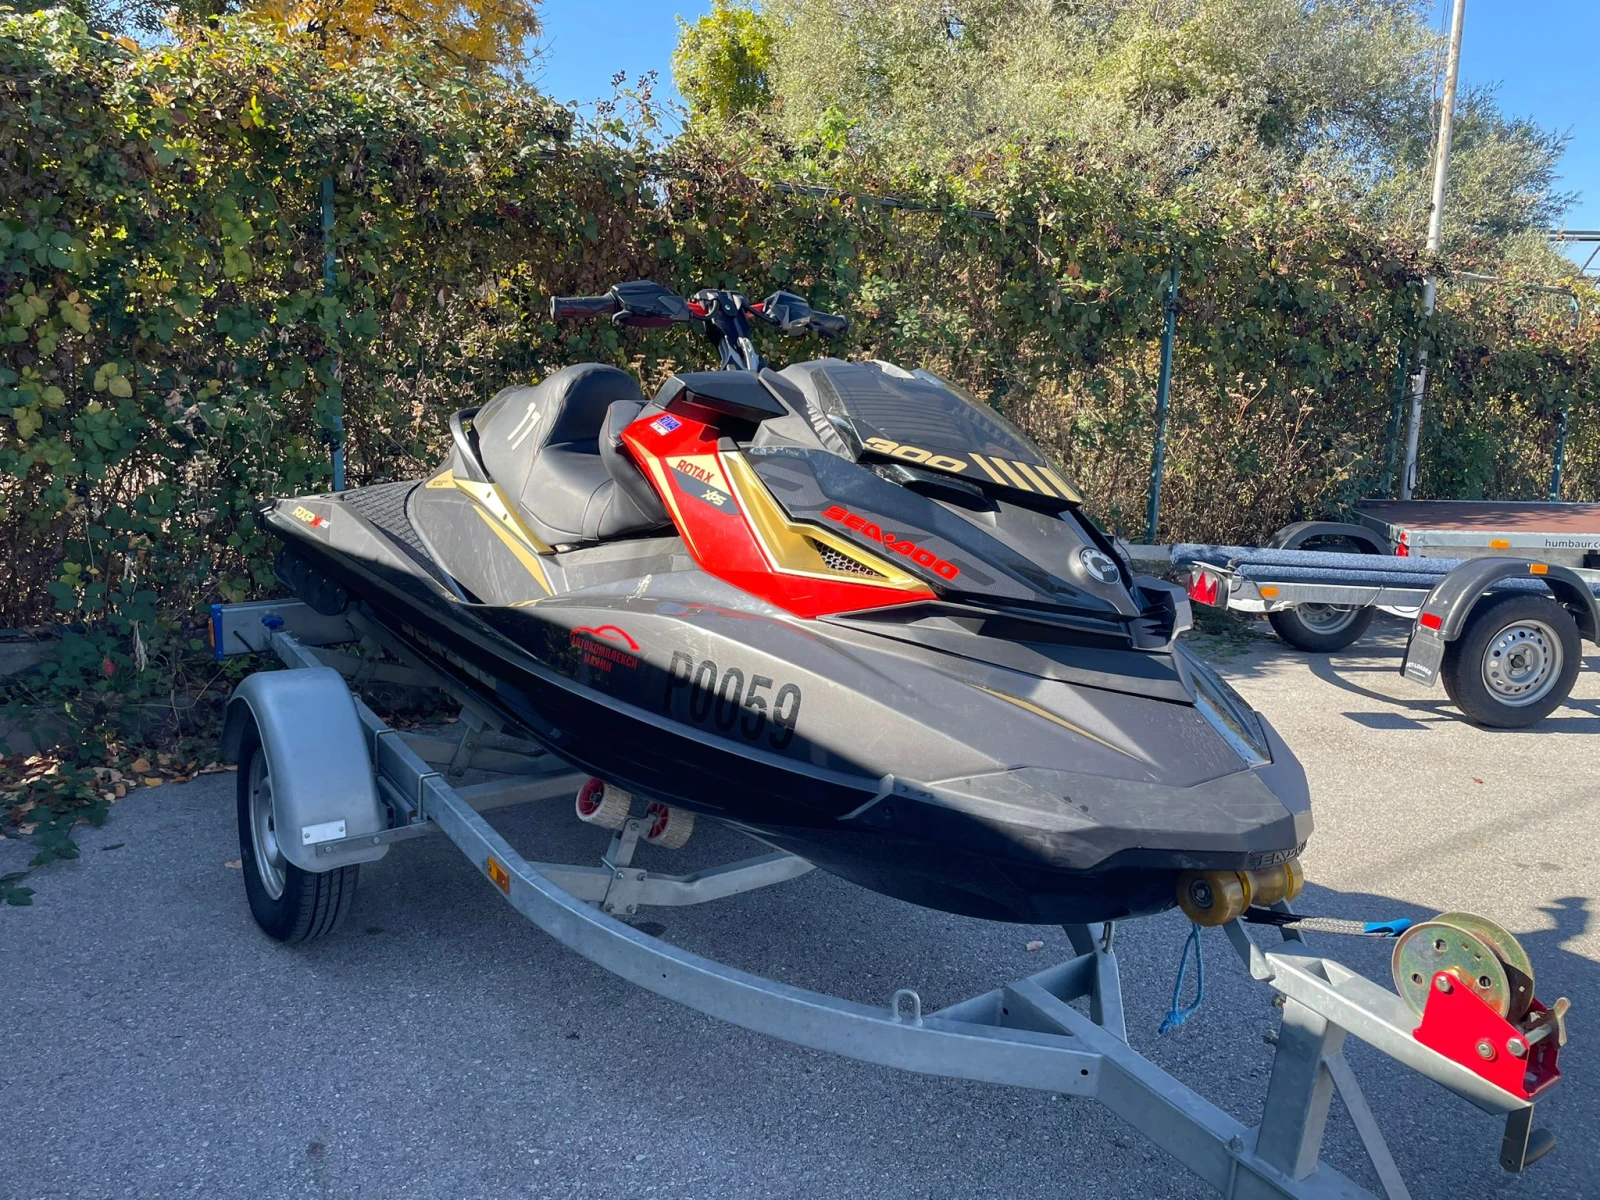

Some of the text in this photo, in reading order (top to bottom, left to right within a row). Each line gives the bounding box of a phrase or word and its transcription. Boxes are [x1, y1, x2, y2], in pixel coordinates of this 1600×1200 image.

[862, 437, 968, 473] 300
[676, 459, 714, 484] ROTAX
[700, 489, 727, 506] XPS
[1544, 539, 1600, 549] humbaur.c
[570, 635, 638, 670] АВТОКОМПЛЕКСИ
[662, 650, 802, 751] P0059
